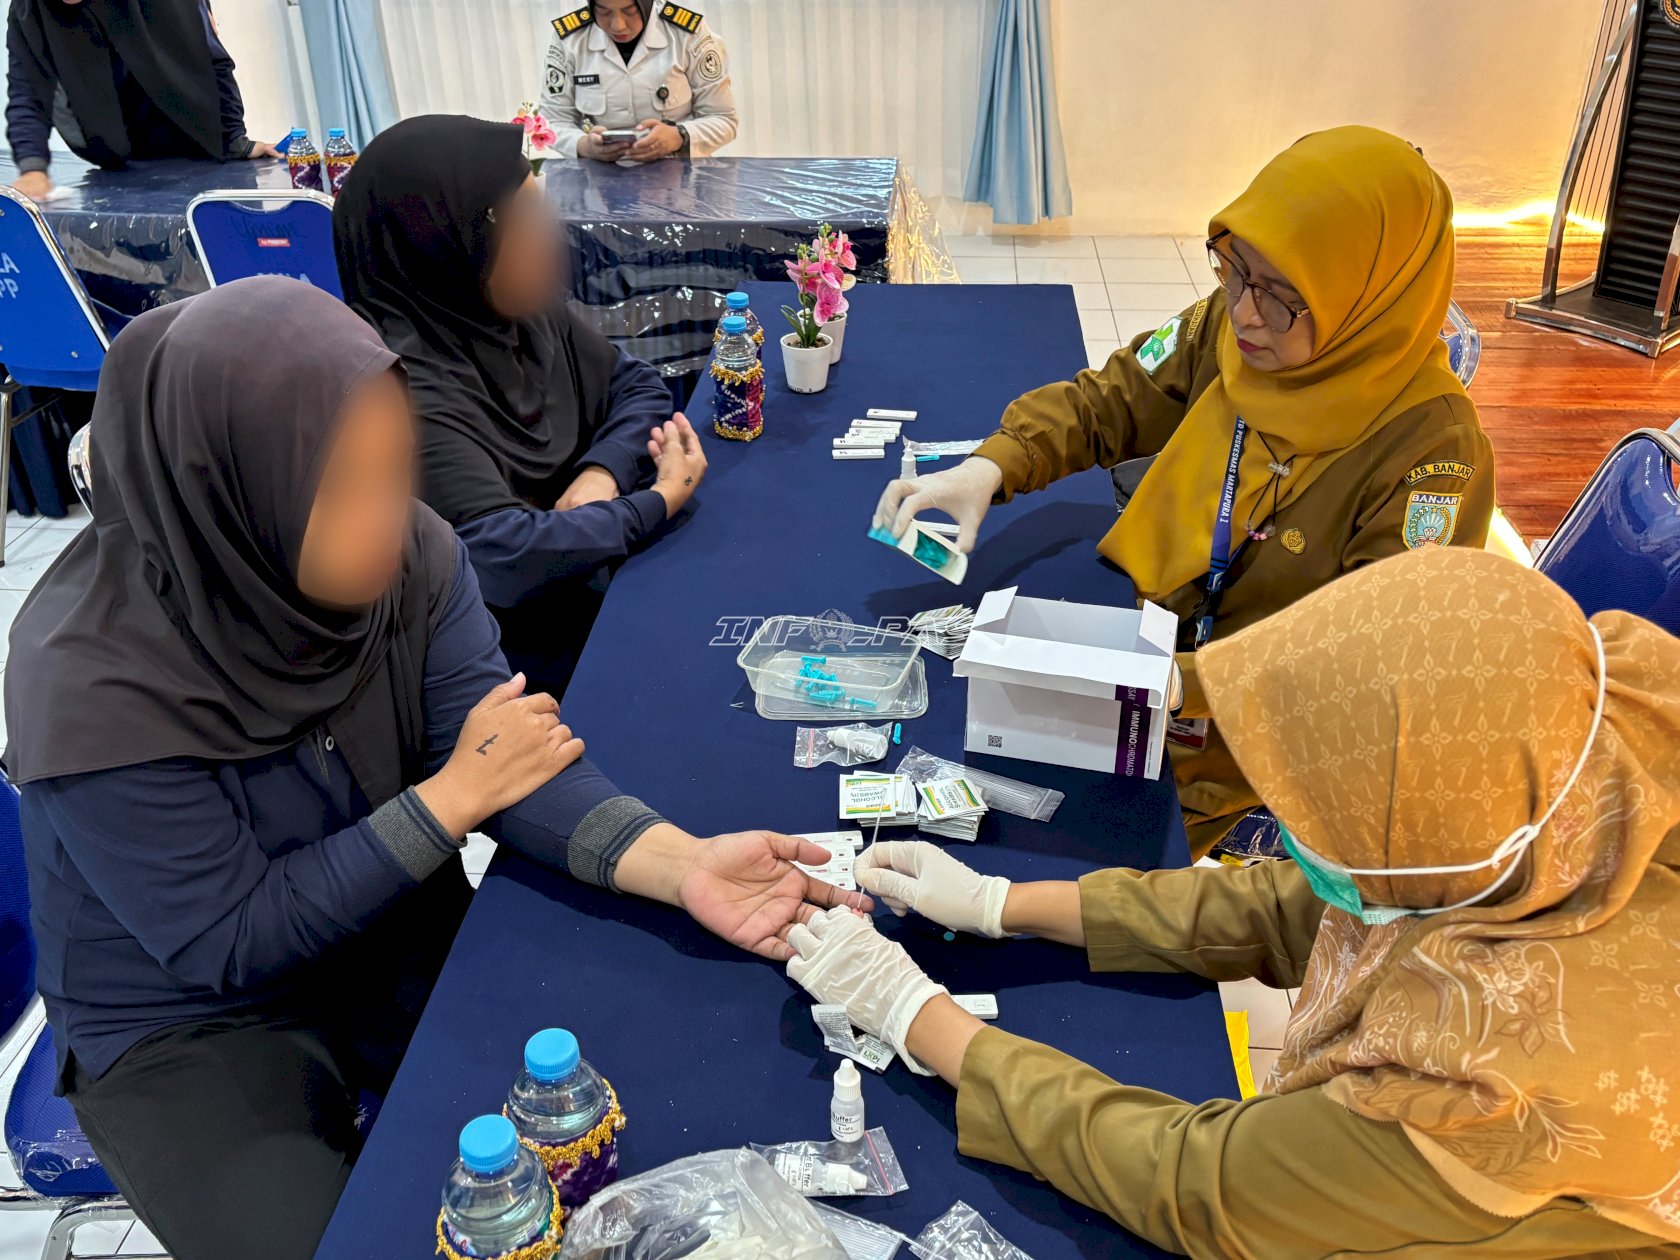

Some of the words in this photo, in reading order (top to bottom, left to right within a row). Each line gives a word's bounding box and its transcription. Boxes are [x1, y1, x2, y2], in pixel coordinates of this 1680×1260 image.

[1228, 430, 1244, 474] PUSKESMAS
[1433, 463, 1472, 479] BANJAR
[1220, 473, 1235, 517] MARTAPURA
[1411, 494, 1459, 505] BANJAR
[1125, 710, 1141, 777] IMMUNOCHROMATO
